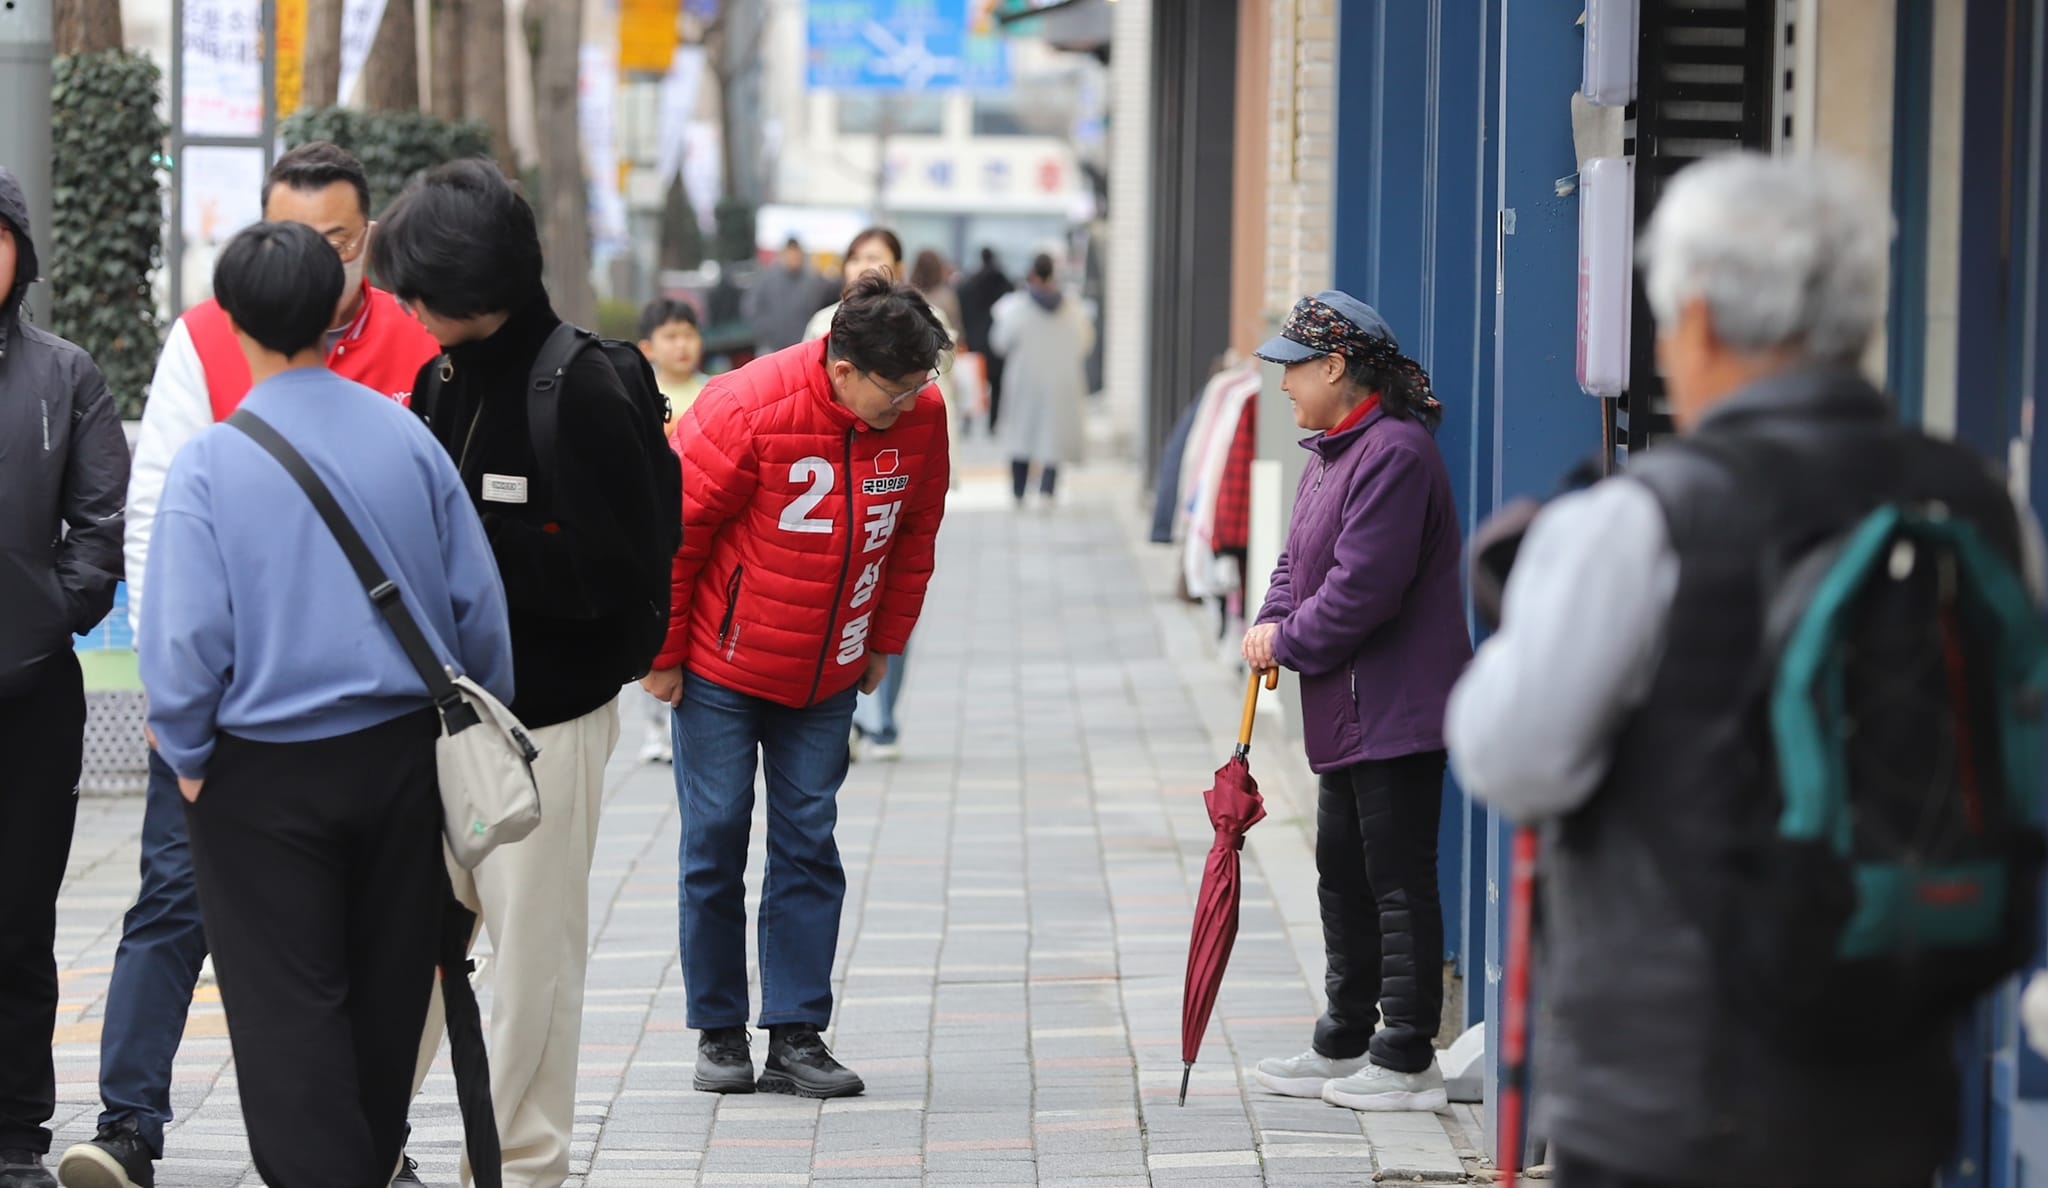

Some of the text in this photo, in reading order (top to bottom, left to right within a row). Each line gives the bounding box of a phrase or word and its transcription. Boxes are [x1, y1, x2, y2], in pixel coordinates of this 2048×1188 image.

[778, 456, 835, 534] 2
[863, 476, 908, 494] 국민의힘
[836, 500, 902, 666] 권성동
